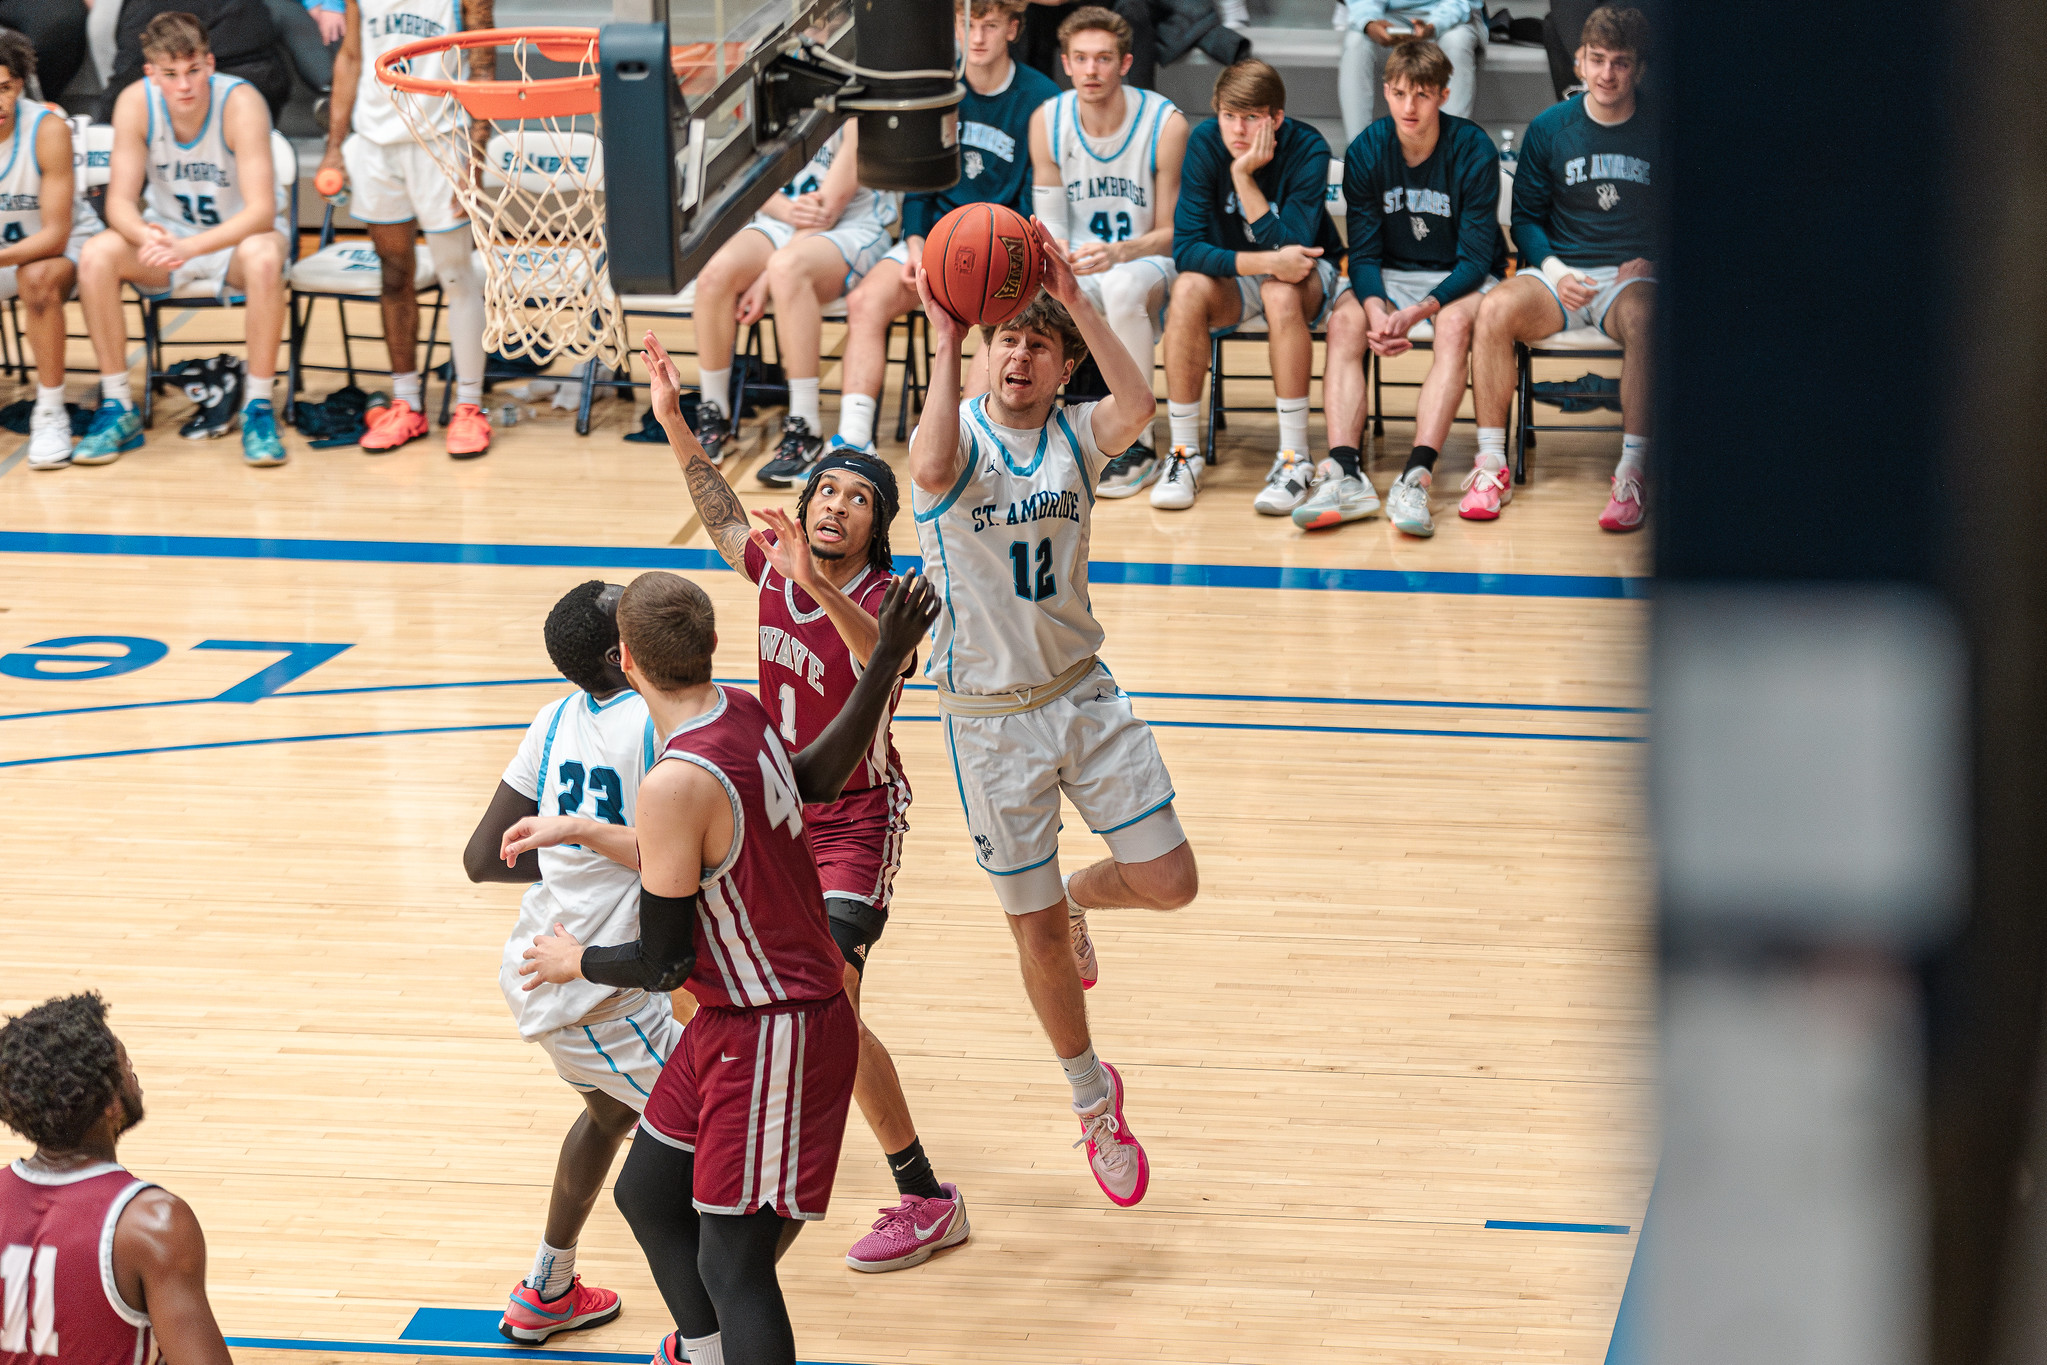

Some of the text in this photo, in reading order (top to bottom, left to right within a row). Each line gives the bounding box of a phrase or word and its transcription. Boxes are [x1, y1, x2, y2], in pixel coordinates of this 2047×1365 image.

[1565, 156, 1588, 187] ST.
[1088, 210, 1132, 244] 42
[971, 489, 1080, 533] ST. AMBROSE
[1009, 536, 1057, 603] 12
[759, 625, 825, 697] WAVE
[778, 682, 797, 746] 1
[0, 1242, 60, 1358] 11
